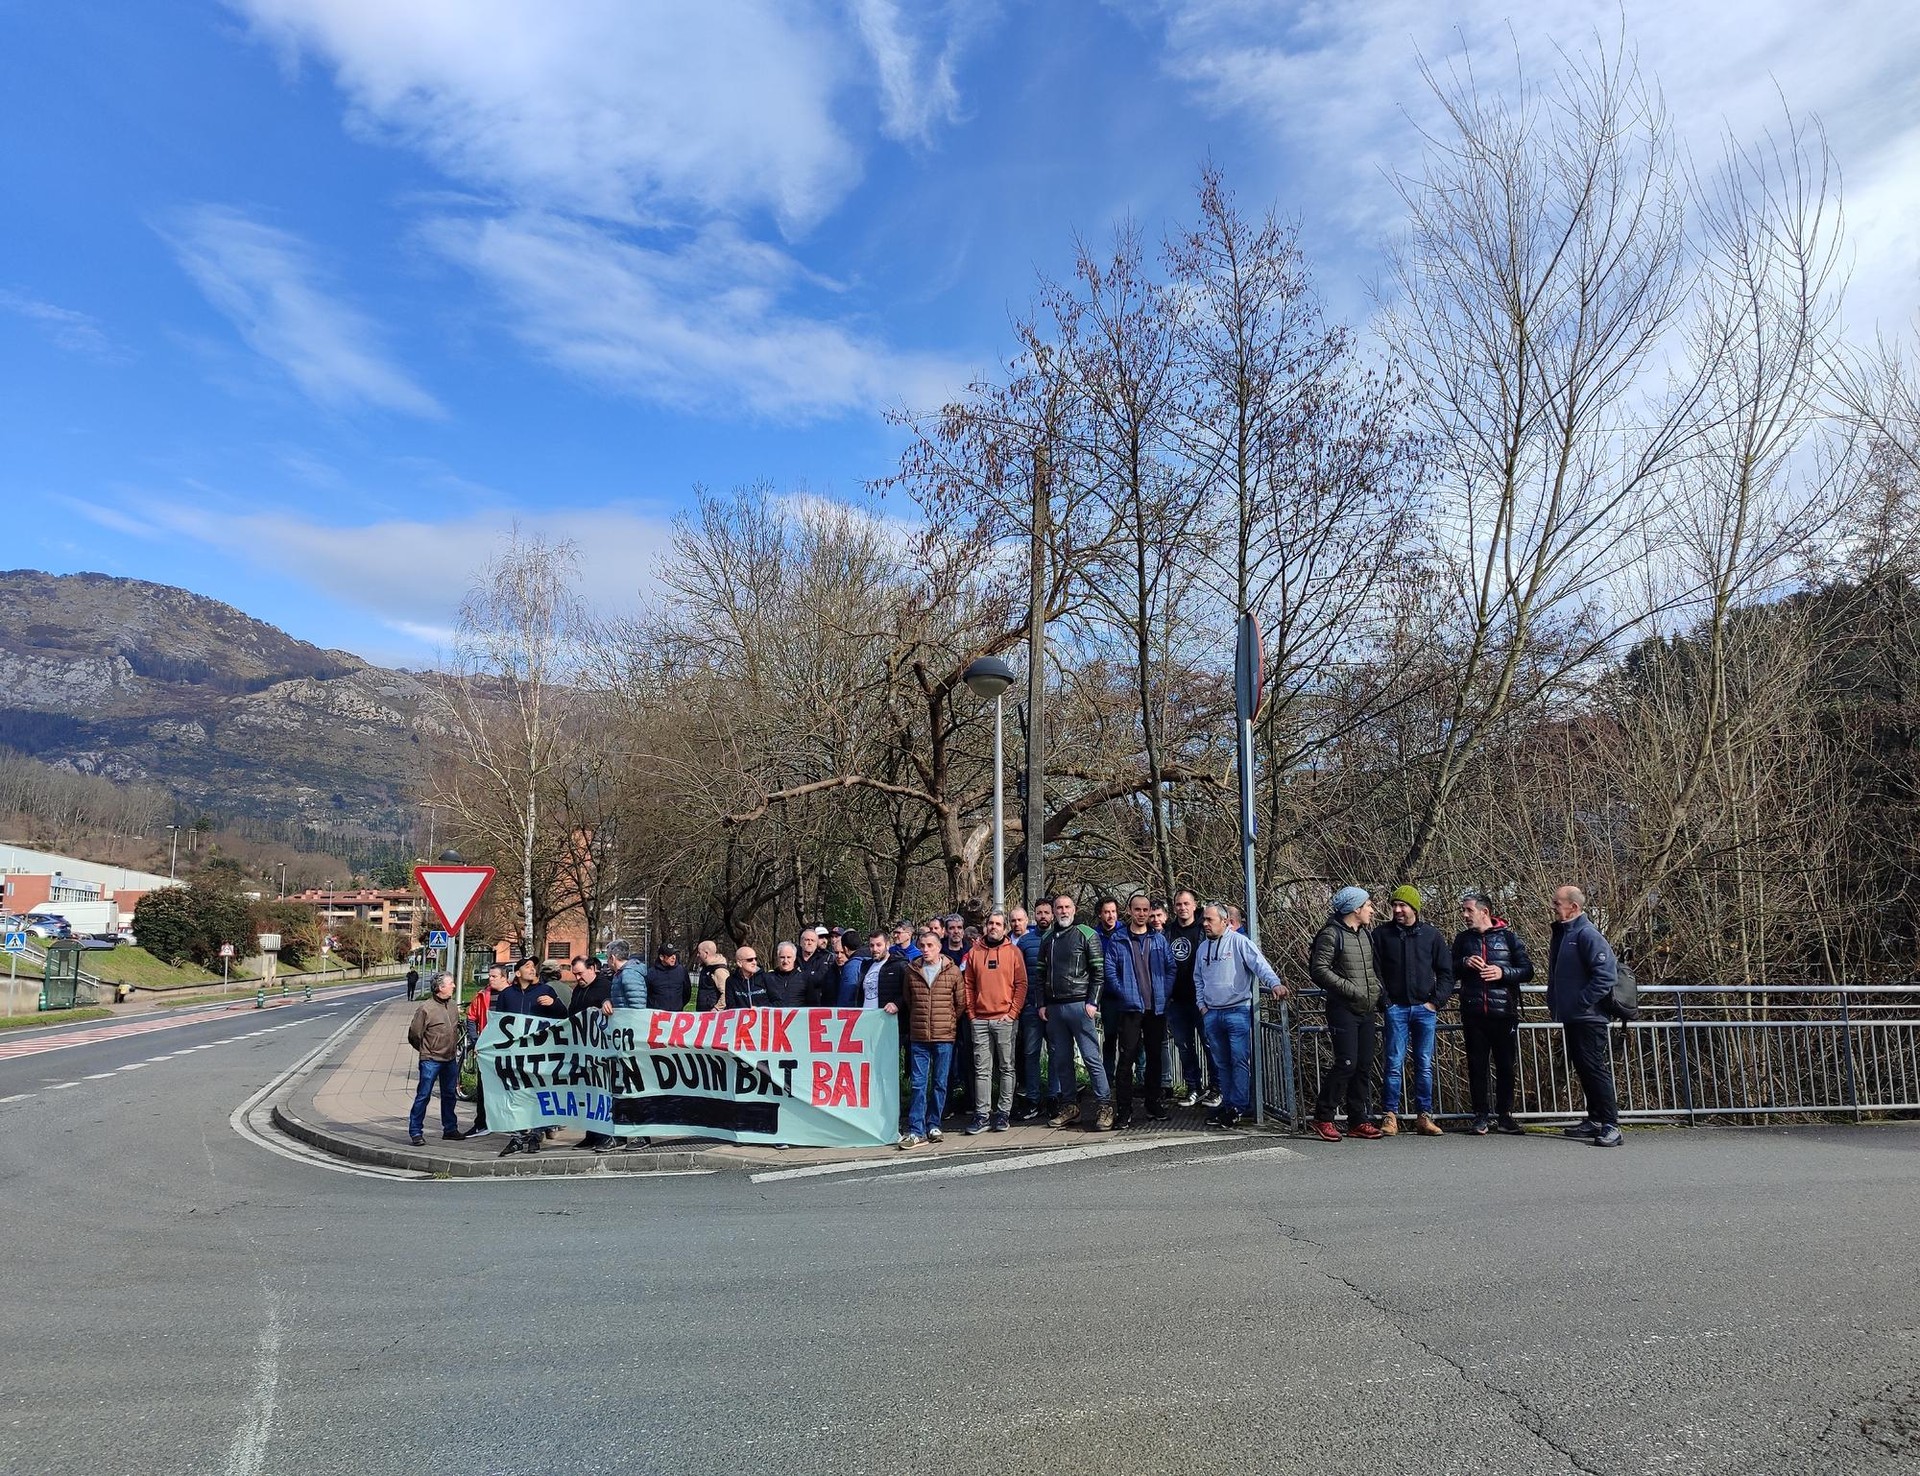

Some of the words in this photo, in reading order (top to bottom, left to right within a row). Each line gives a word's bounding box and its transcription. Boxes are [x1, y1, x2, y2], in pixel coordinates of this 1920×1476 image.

[647, 1008, 799, 1052] ERTERIK
[808, 1008, 863, 1053] EZ
[649, 1053, 728, 1091] DUIN
[732, 1056, 798, 1097] BAT
[811, 1060, 870, 1108] BAI
